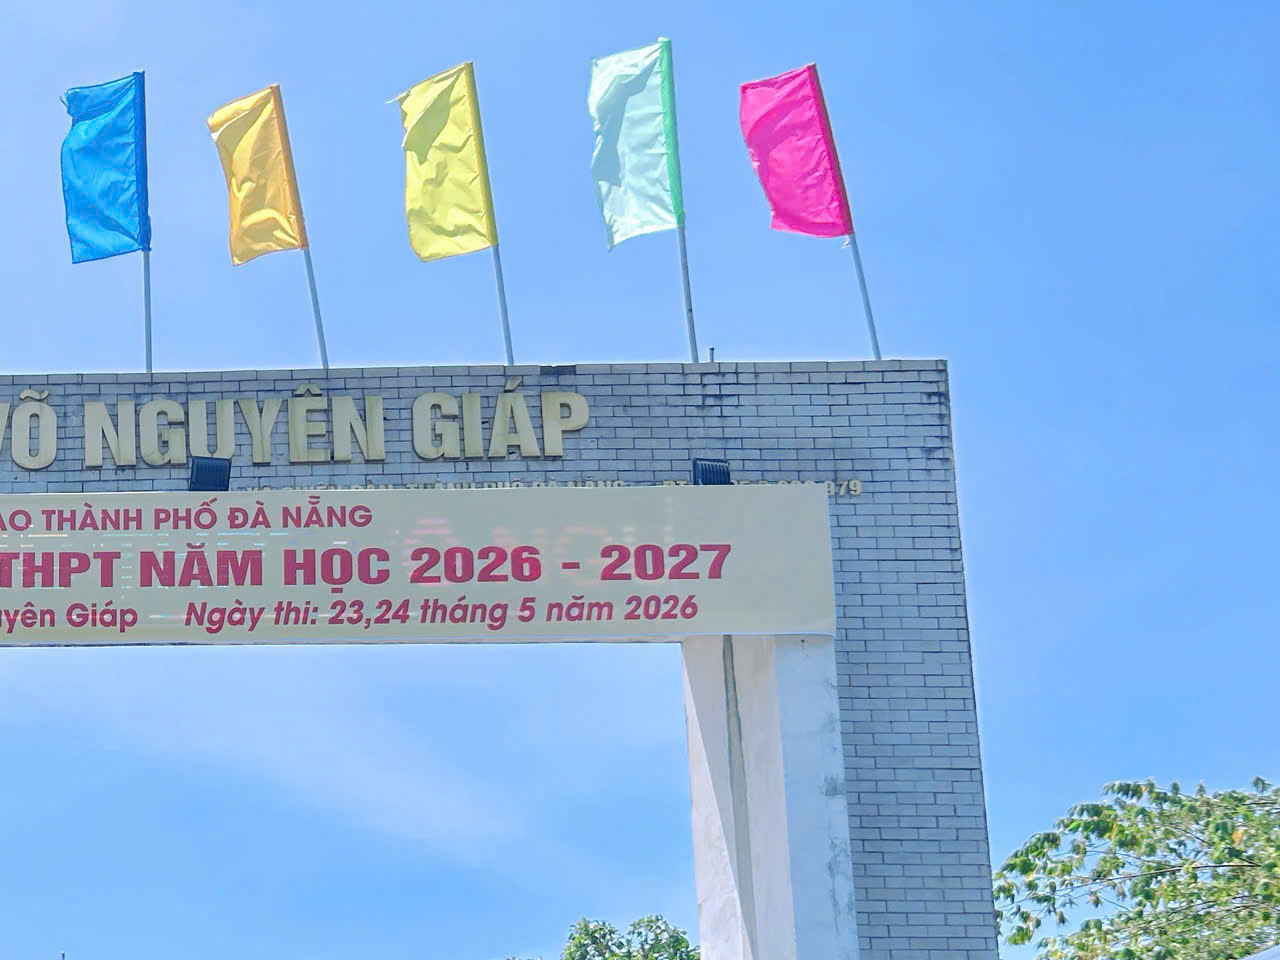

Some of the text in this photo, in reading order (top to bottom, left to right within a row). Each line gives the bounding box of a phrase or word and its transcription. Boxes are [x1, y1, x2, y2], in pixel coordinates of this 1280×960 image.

[84, 382, 386, 468] NGUYÊN
[412, 378, 591, 460] GIÁP
[41, 502, 142, 532] THÀNH
[154, 497, 218, 531] PHỐ
[227, 500, 271, 530] ĐÀ
[282, 495, 373, 529] NẴNG
[139, 542, 263, 588] NĂM
[283, 547, 391, 594] HỌC
[409, 545, 542, 585] 2026
[561, 561, 581, 570] -
[600, 543, 732, 582] 2027
[65, 600, 139, 633] Giáp
[183, 599, 266, 634] Ngày
[273, 601, 320, 626] thi:
[327, 599, 411, 630] 23,24
[419, 594, 509, 631] tháng
[517, 597, 537, 623] 5
[545, 595, 614, 622] năm
[623, 594, 699, 620] 2026
